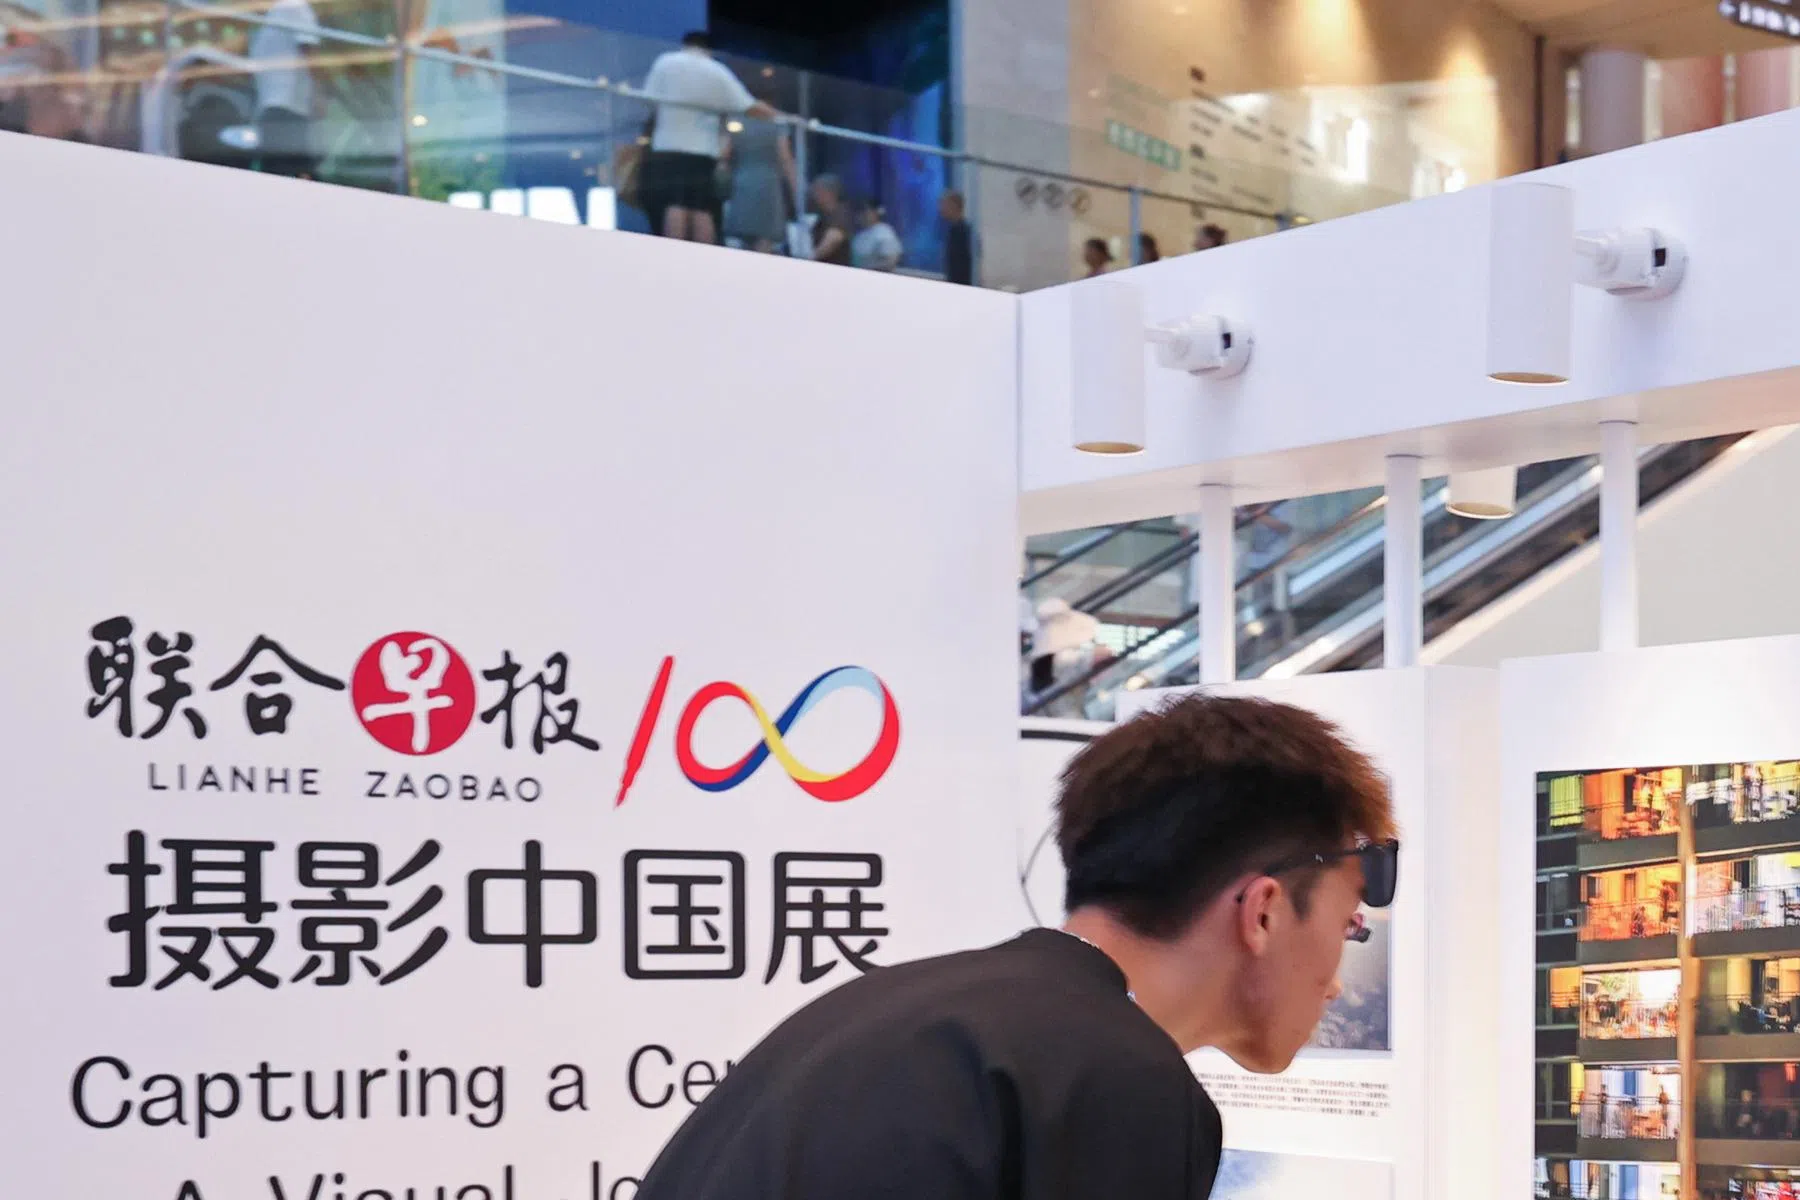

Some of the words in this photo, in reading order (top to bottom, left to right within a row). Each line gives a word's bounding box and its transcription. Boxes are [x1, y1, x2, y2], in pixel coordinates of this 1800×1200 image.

[86, 616, 602, 758] 联合早报
[149, 763, 321, 796] LIANHE
[366, 770, 543, 803] ZAOBAO
[106, 829, 890, 991] 摄影中国展
[71, 1049, 508, 1139] Capturing
[547, 1064, 589, 1112] a
[628, 1044, 732, 1110] Ce
